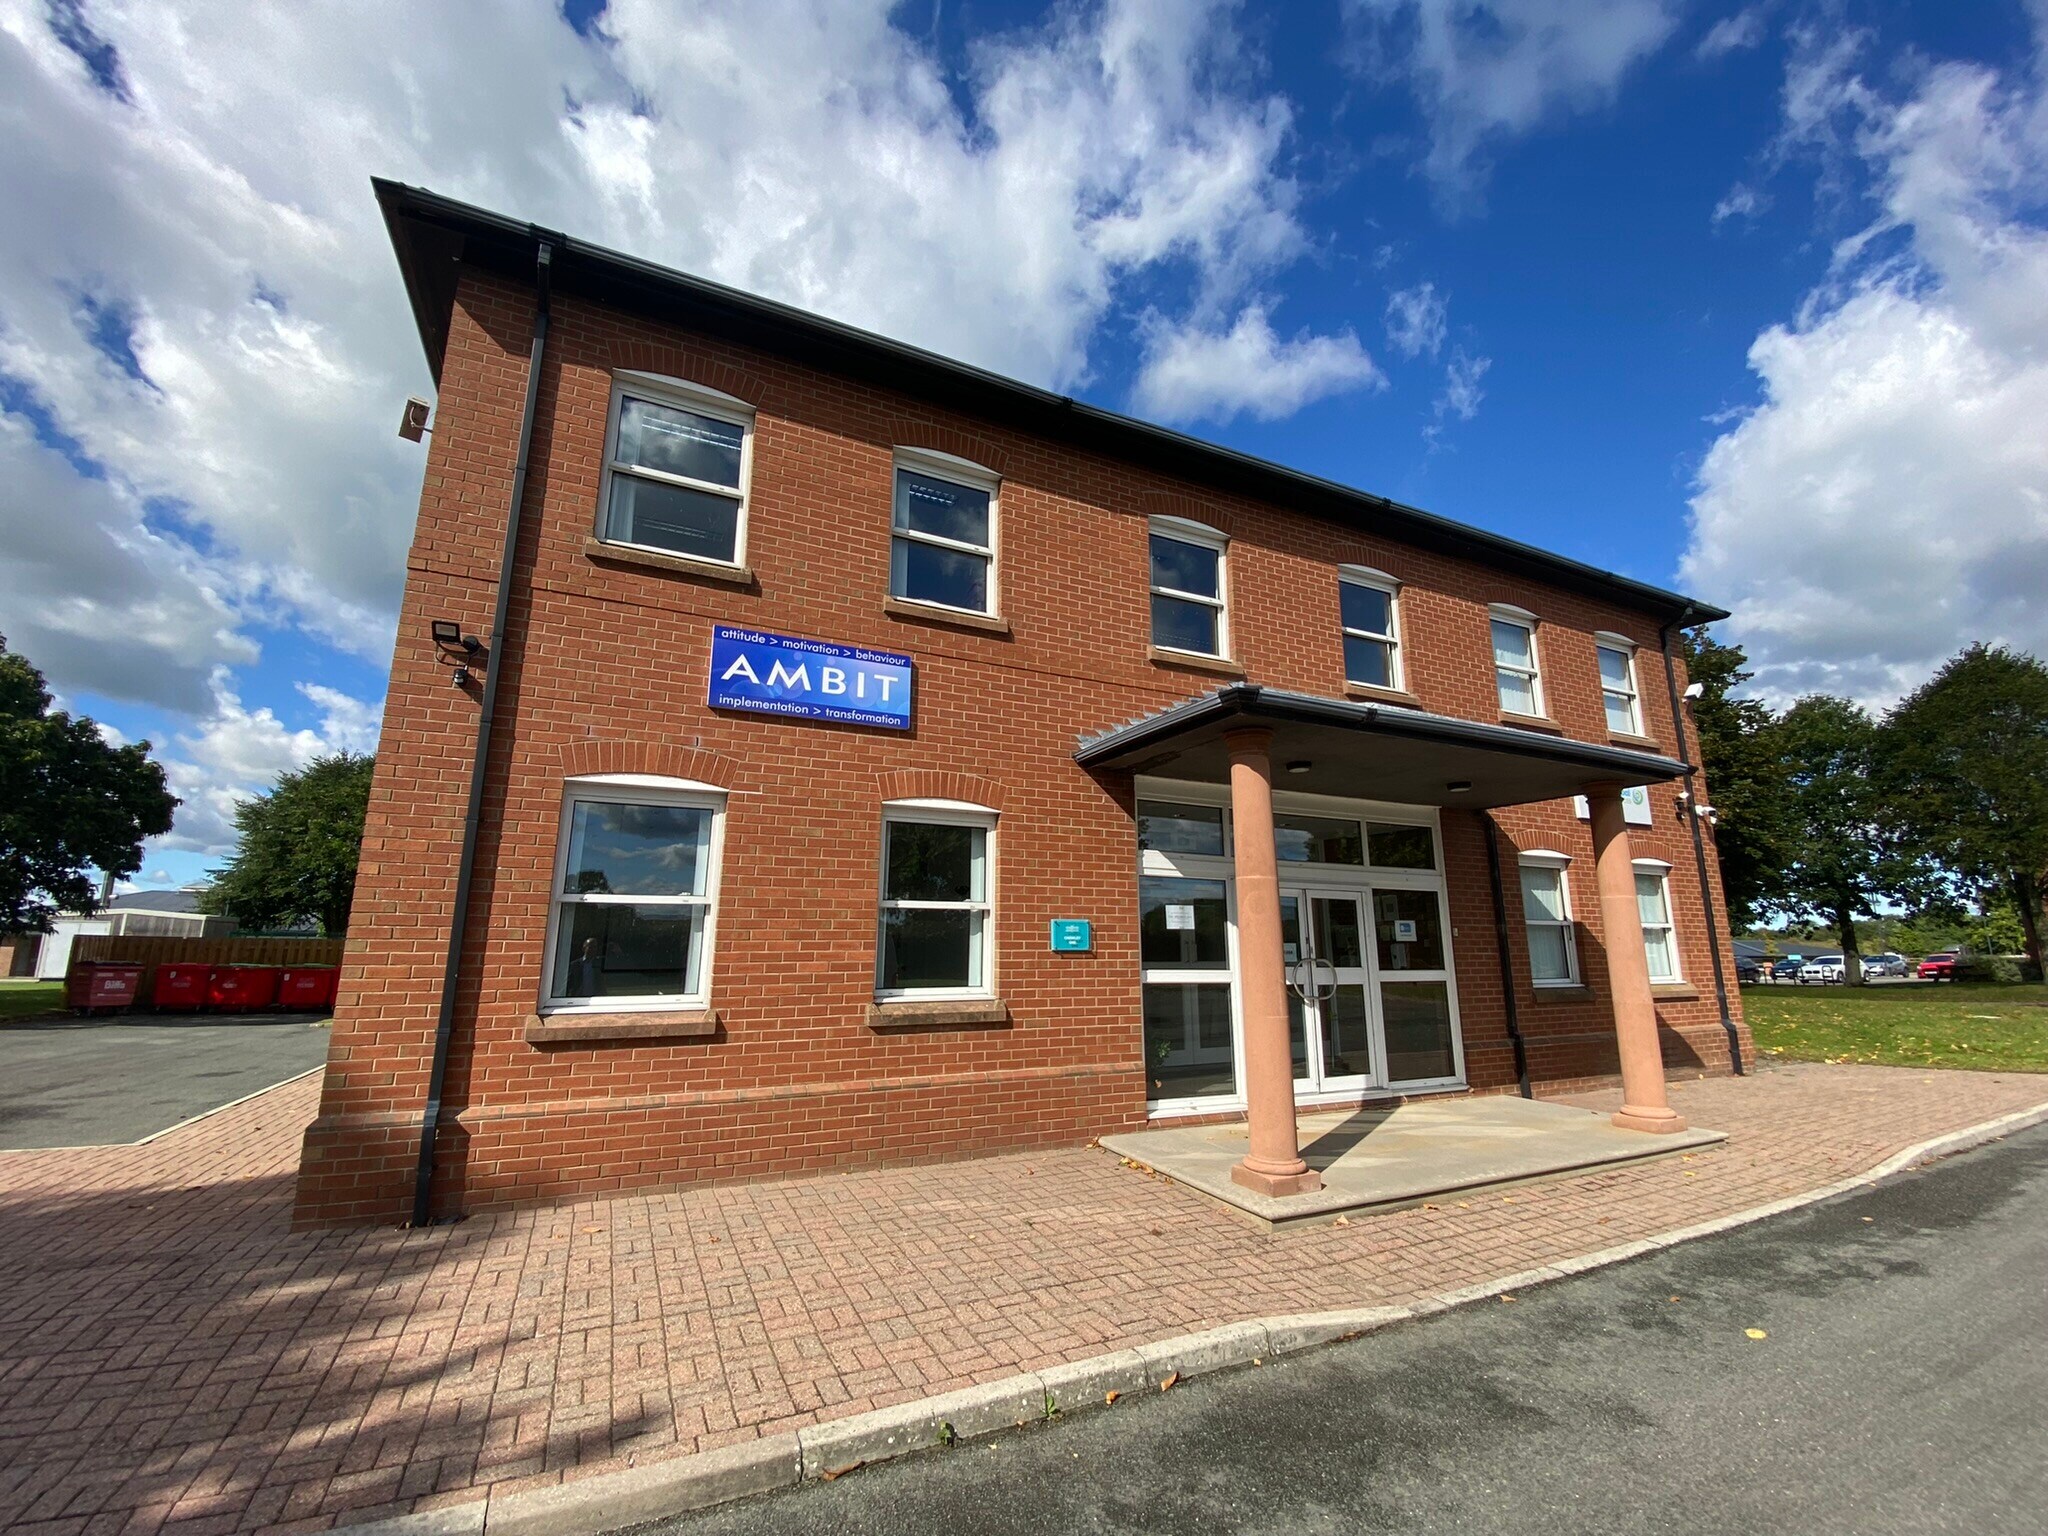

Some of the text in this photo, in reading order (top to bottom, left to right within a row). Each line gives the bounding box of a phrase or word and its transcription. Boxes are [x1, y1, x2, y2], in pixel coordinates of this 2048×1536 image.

[721, 629, 766, 644] attitude
[782, 639, 839, 656] motivation
[855, 649, 906, 666] behaviour
[720, 653, 899, 702] AMBIT
[719, 693, 809, 715] implementation
[825, 708, 901, 726] transformation
